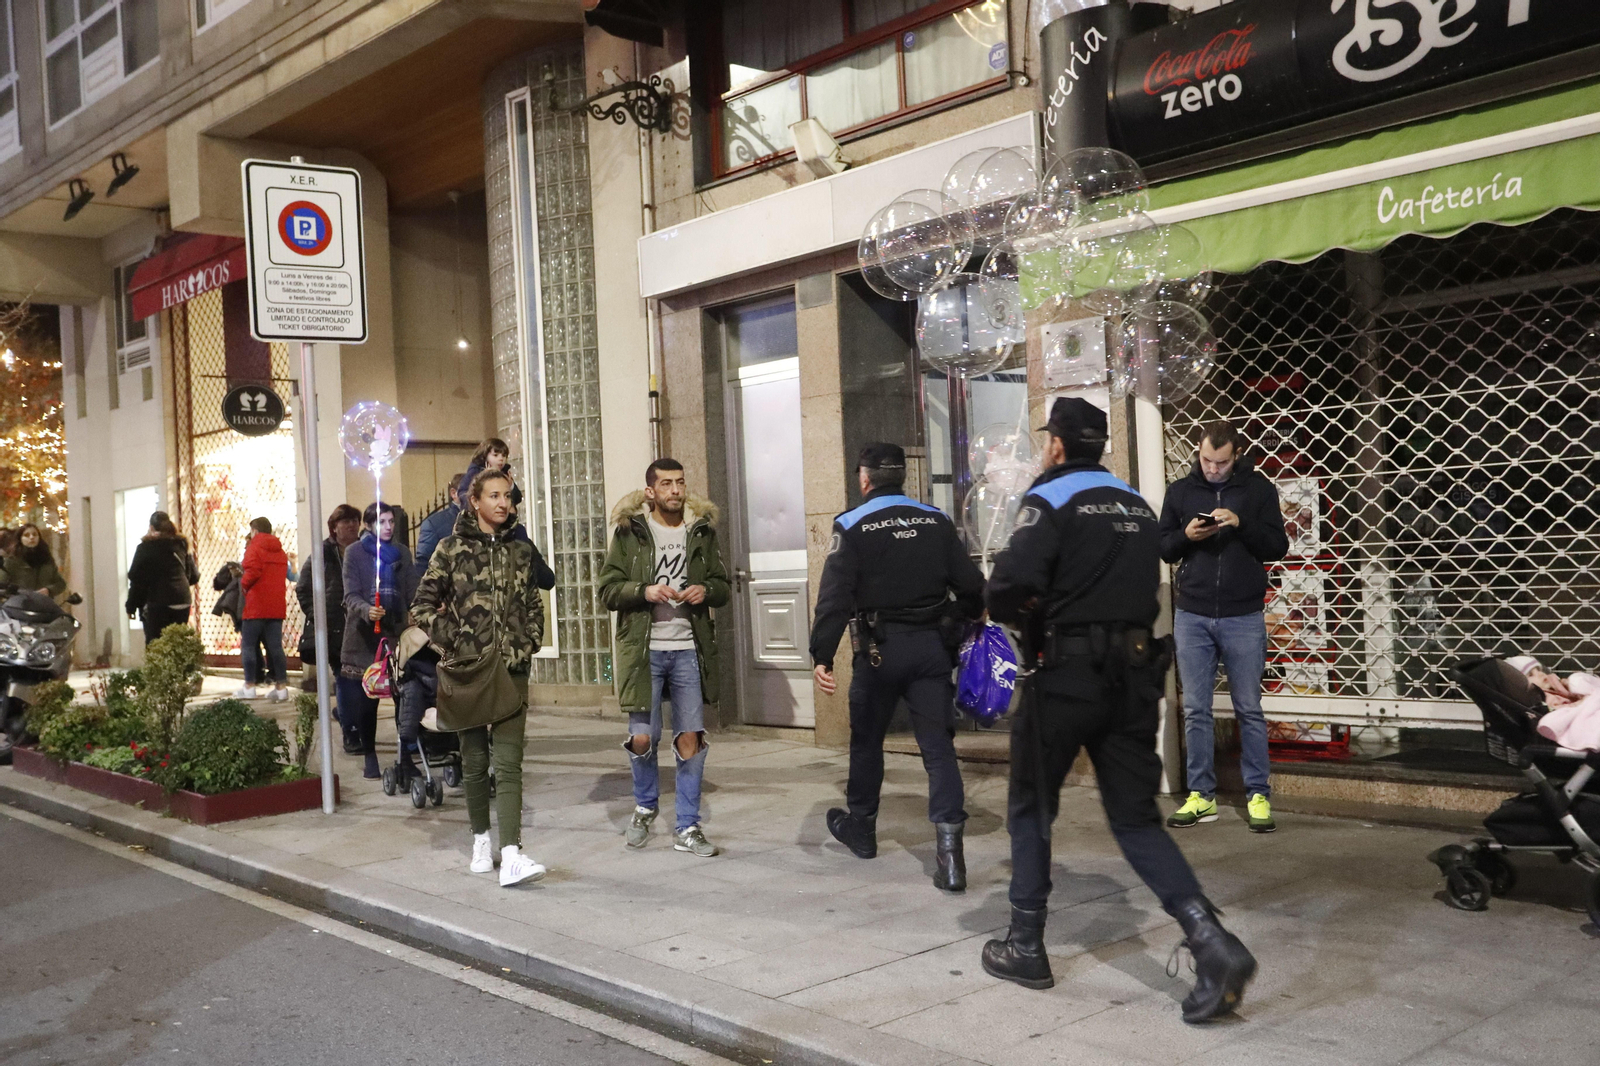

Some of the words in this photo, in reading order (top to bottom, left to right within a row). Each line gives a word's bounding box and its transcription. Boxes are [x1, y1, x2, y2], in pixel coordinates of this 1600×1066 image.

[1160, 71, 1243, 120] zero
[290, 175, 318, 186] X.E.R.
[1377, 172, 1523, 225] Cafetería
[162, 260, 230, 309] HARCOS
[296, 308, 354, 317] ESTACIONAMENTO
[307, 316, 351, 324] CONTROLADO
[278, 323, 300, 331] TICKET
[301, 324, 345, 332] OBRIGATORIO
[232, 415, 276, 426] HARCOS
[861, 517, 900, 532] POLICÍA
[906, 517, 938, 525] LOCAL
[892, 529, 917, 539] VIGO
